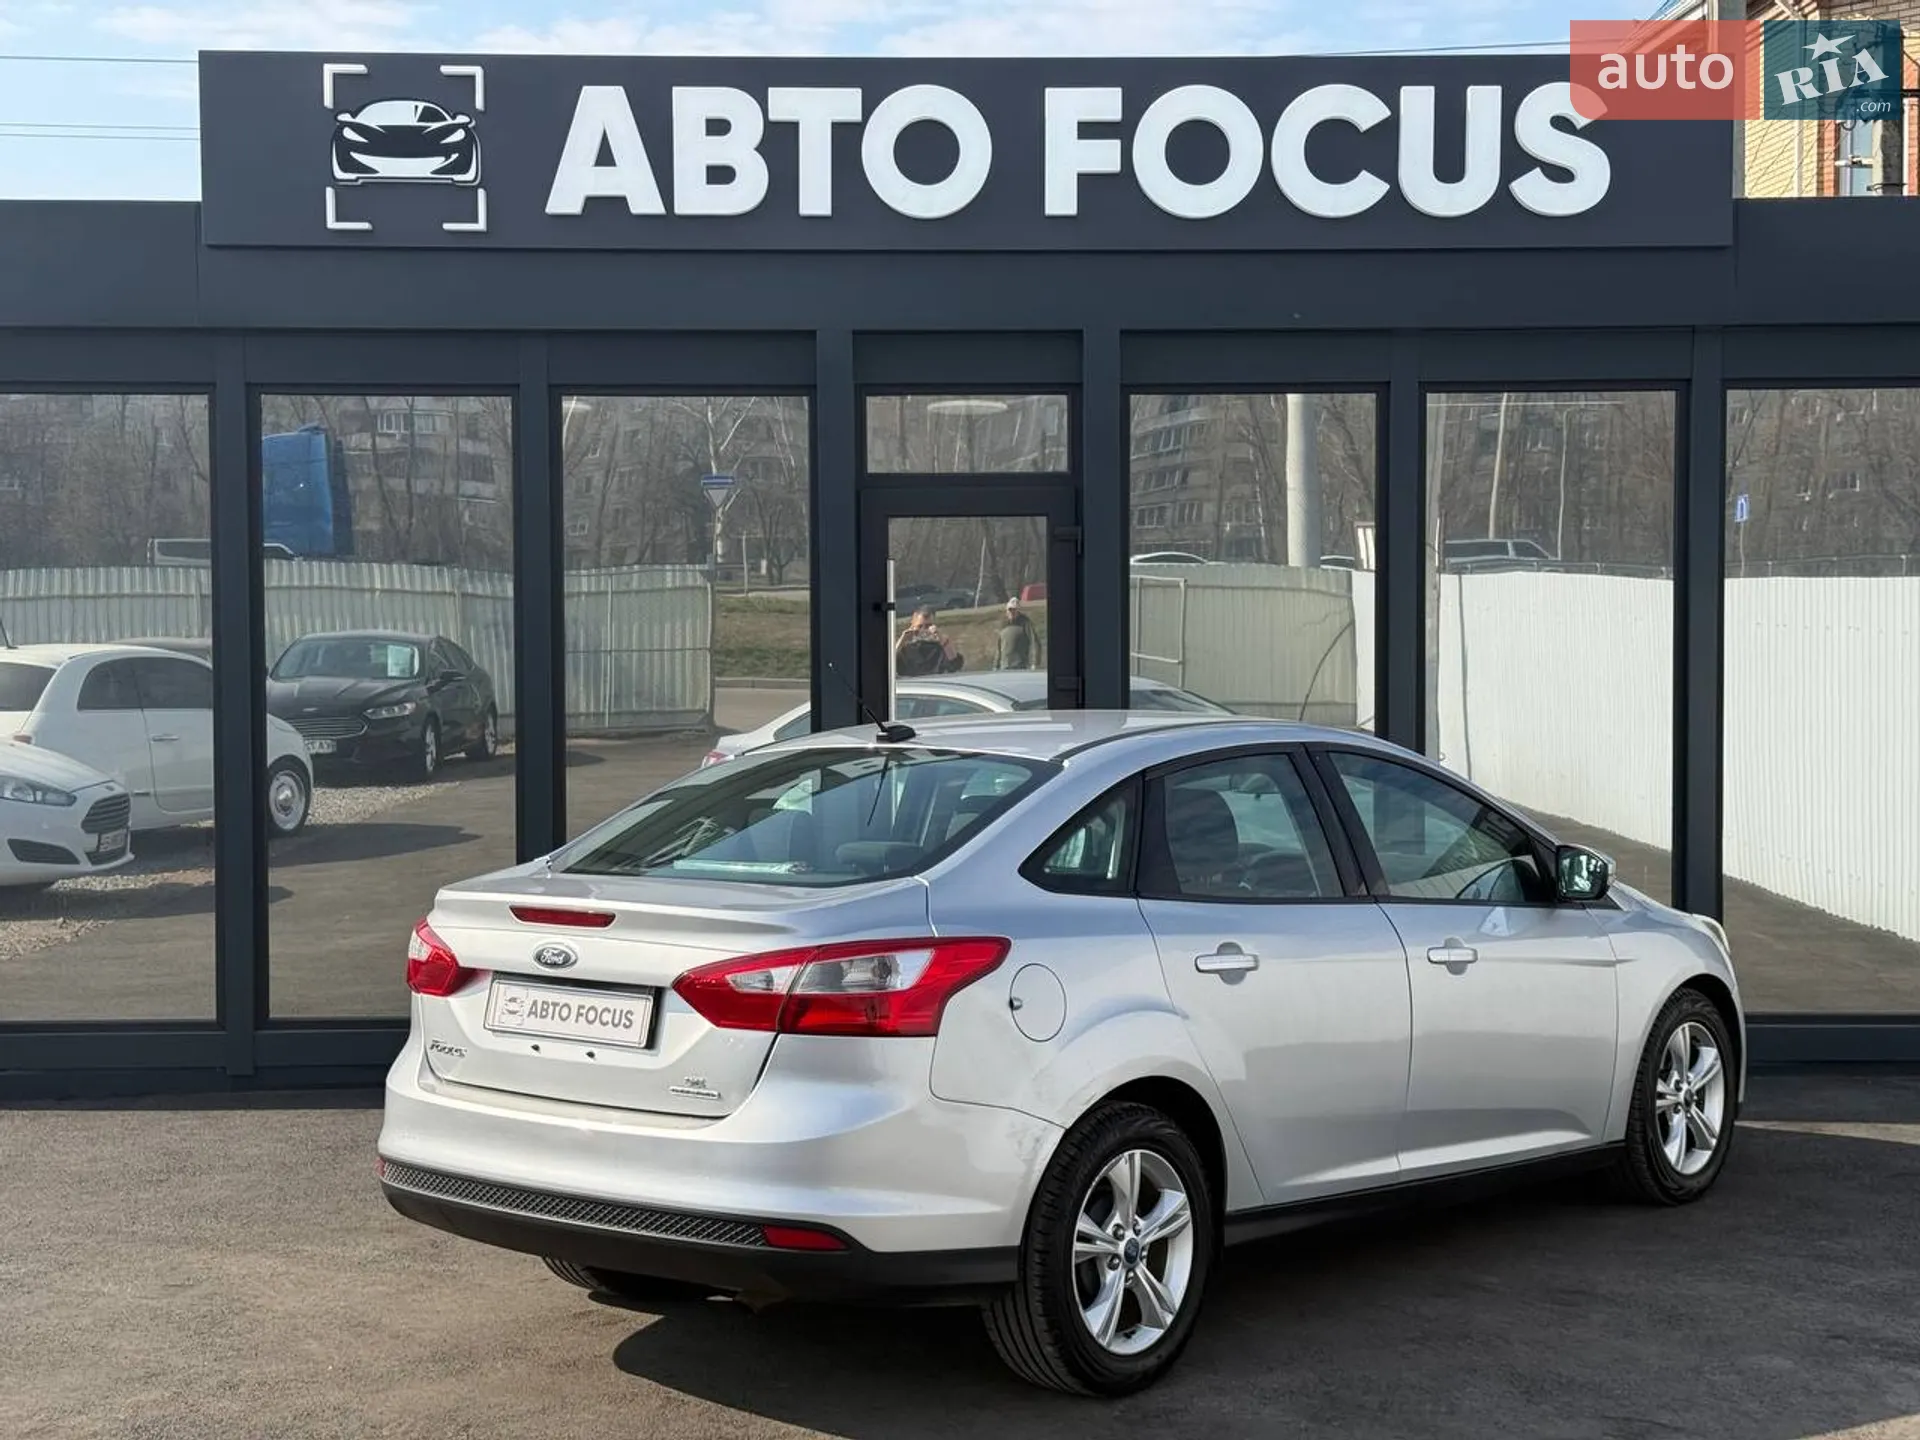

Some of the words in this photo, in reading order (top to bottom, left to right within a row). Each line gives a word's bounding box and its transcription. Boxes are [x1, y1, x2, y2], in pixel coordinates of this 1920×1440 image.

[545, 84, 992, 219] АВТО
[1044, 81, 1612, 219] FOCUS
[527, 999, 572, 1022] АВТО
[575, 1004, 634, 1029] FOCUS
